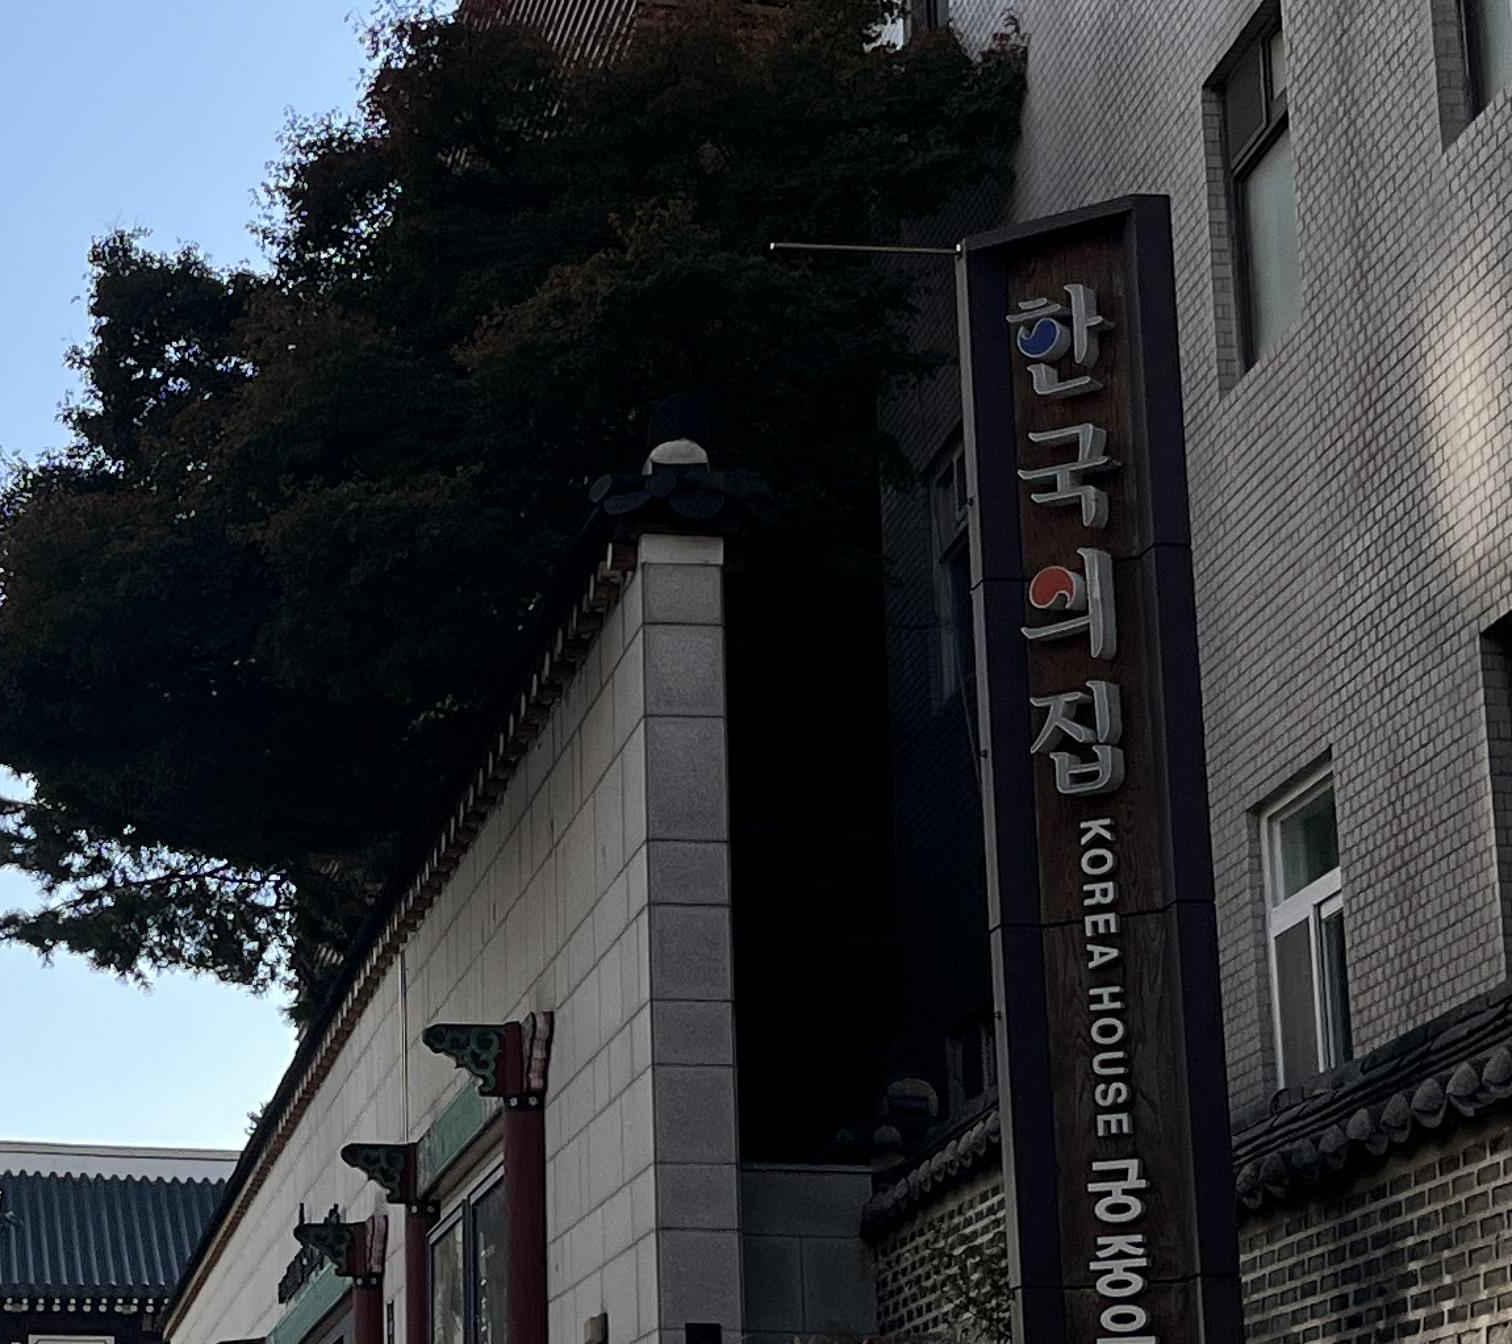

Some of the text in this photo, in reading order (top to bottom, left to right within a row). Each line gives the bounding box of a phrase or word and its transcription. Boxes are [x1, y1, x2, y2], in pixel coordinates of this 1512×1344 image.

[1005, 281, 1126, 796] 한국의집
[1078, 817, 1122, 971] KOREA
[1088, 984, 1132, 1138] HOUSE
